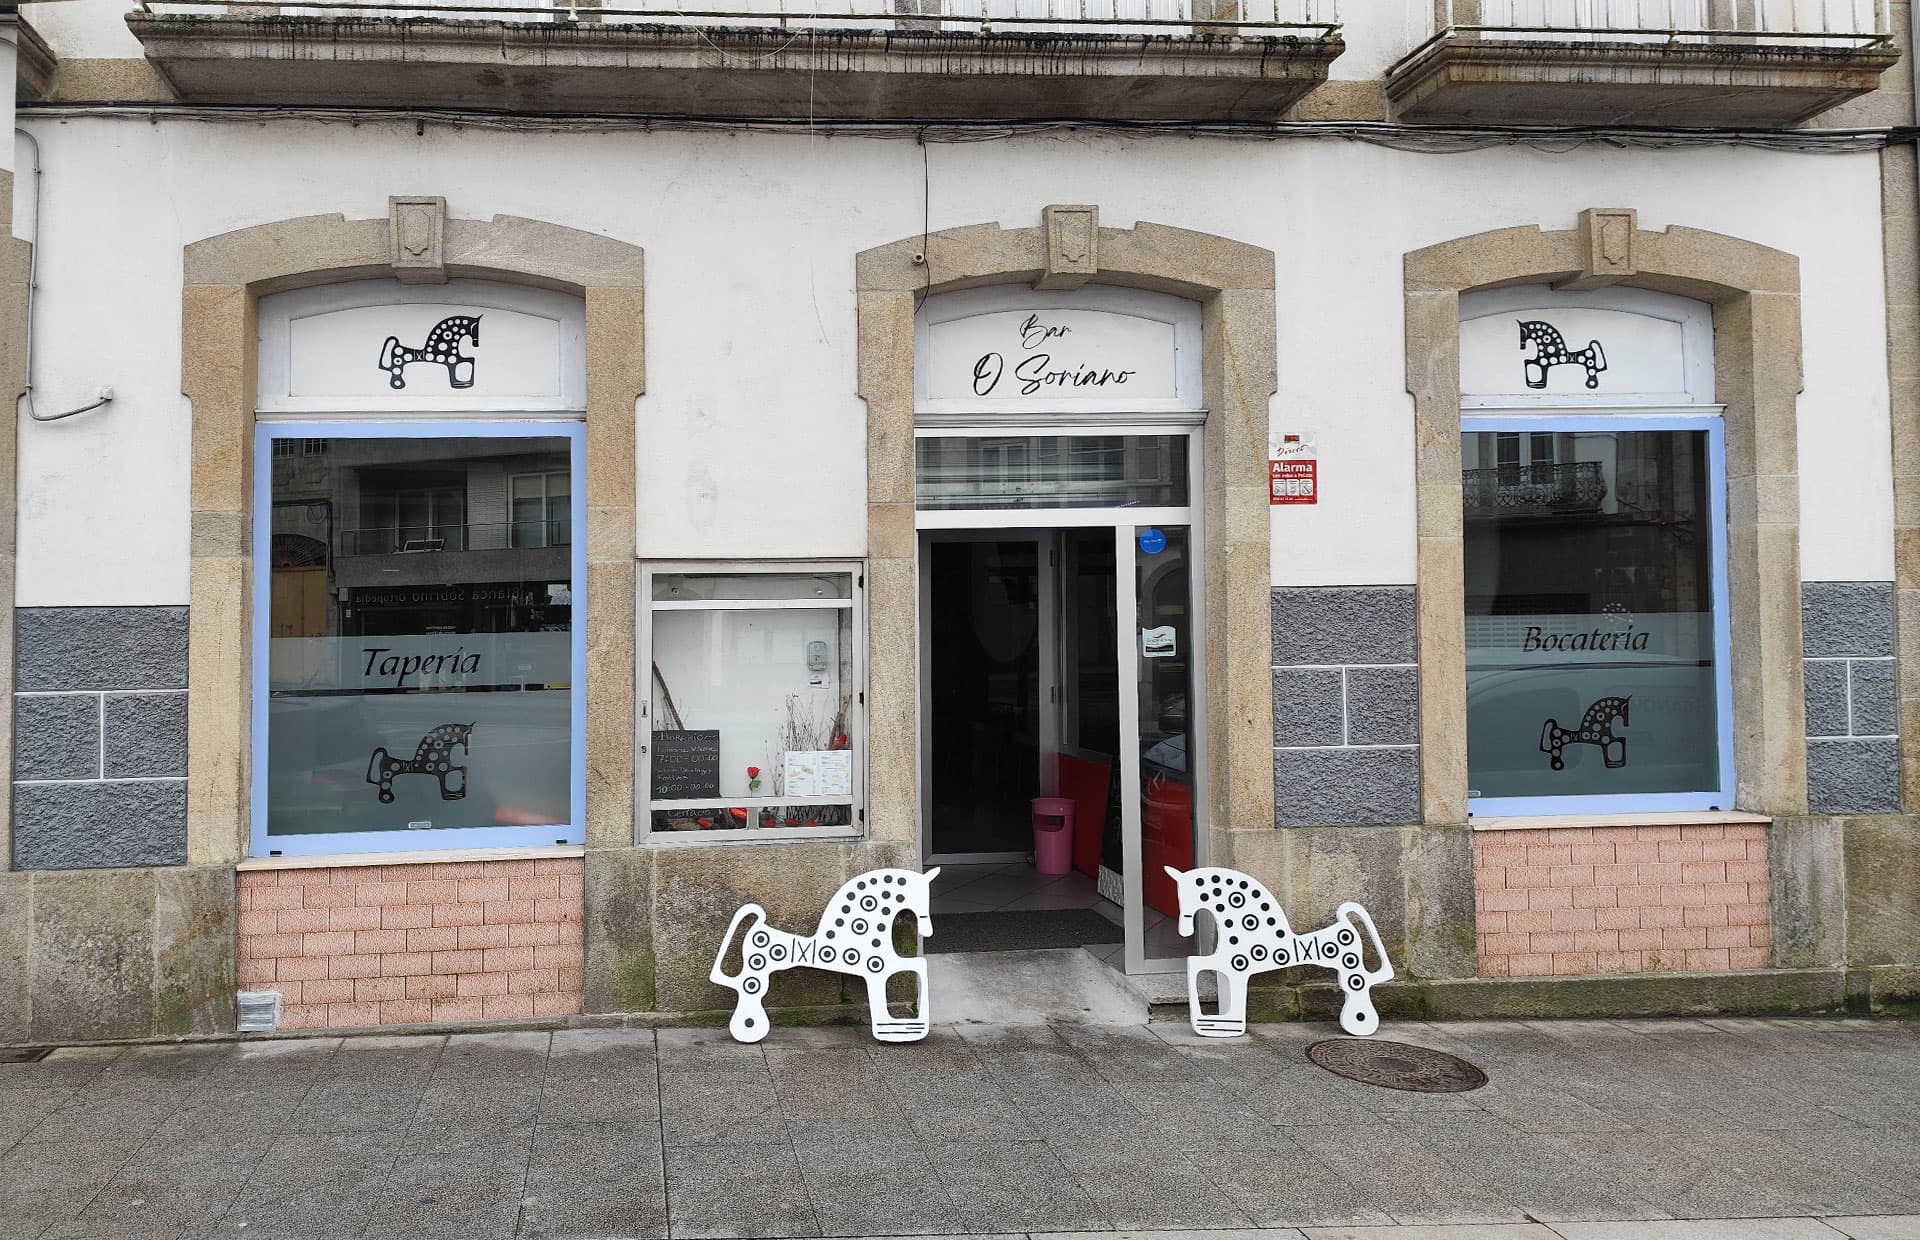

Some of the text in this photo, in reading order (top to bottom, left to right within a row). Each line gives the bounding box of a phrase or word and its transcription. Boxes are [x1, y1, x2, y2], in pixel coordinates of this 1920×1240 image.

[1019, 313, 1072, 350] Bar
[973, 352, 1136, 396] O Soriano
[1272, 462, 1313, 473] Alarma
[362, 646, 481, 687] Tapería
